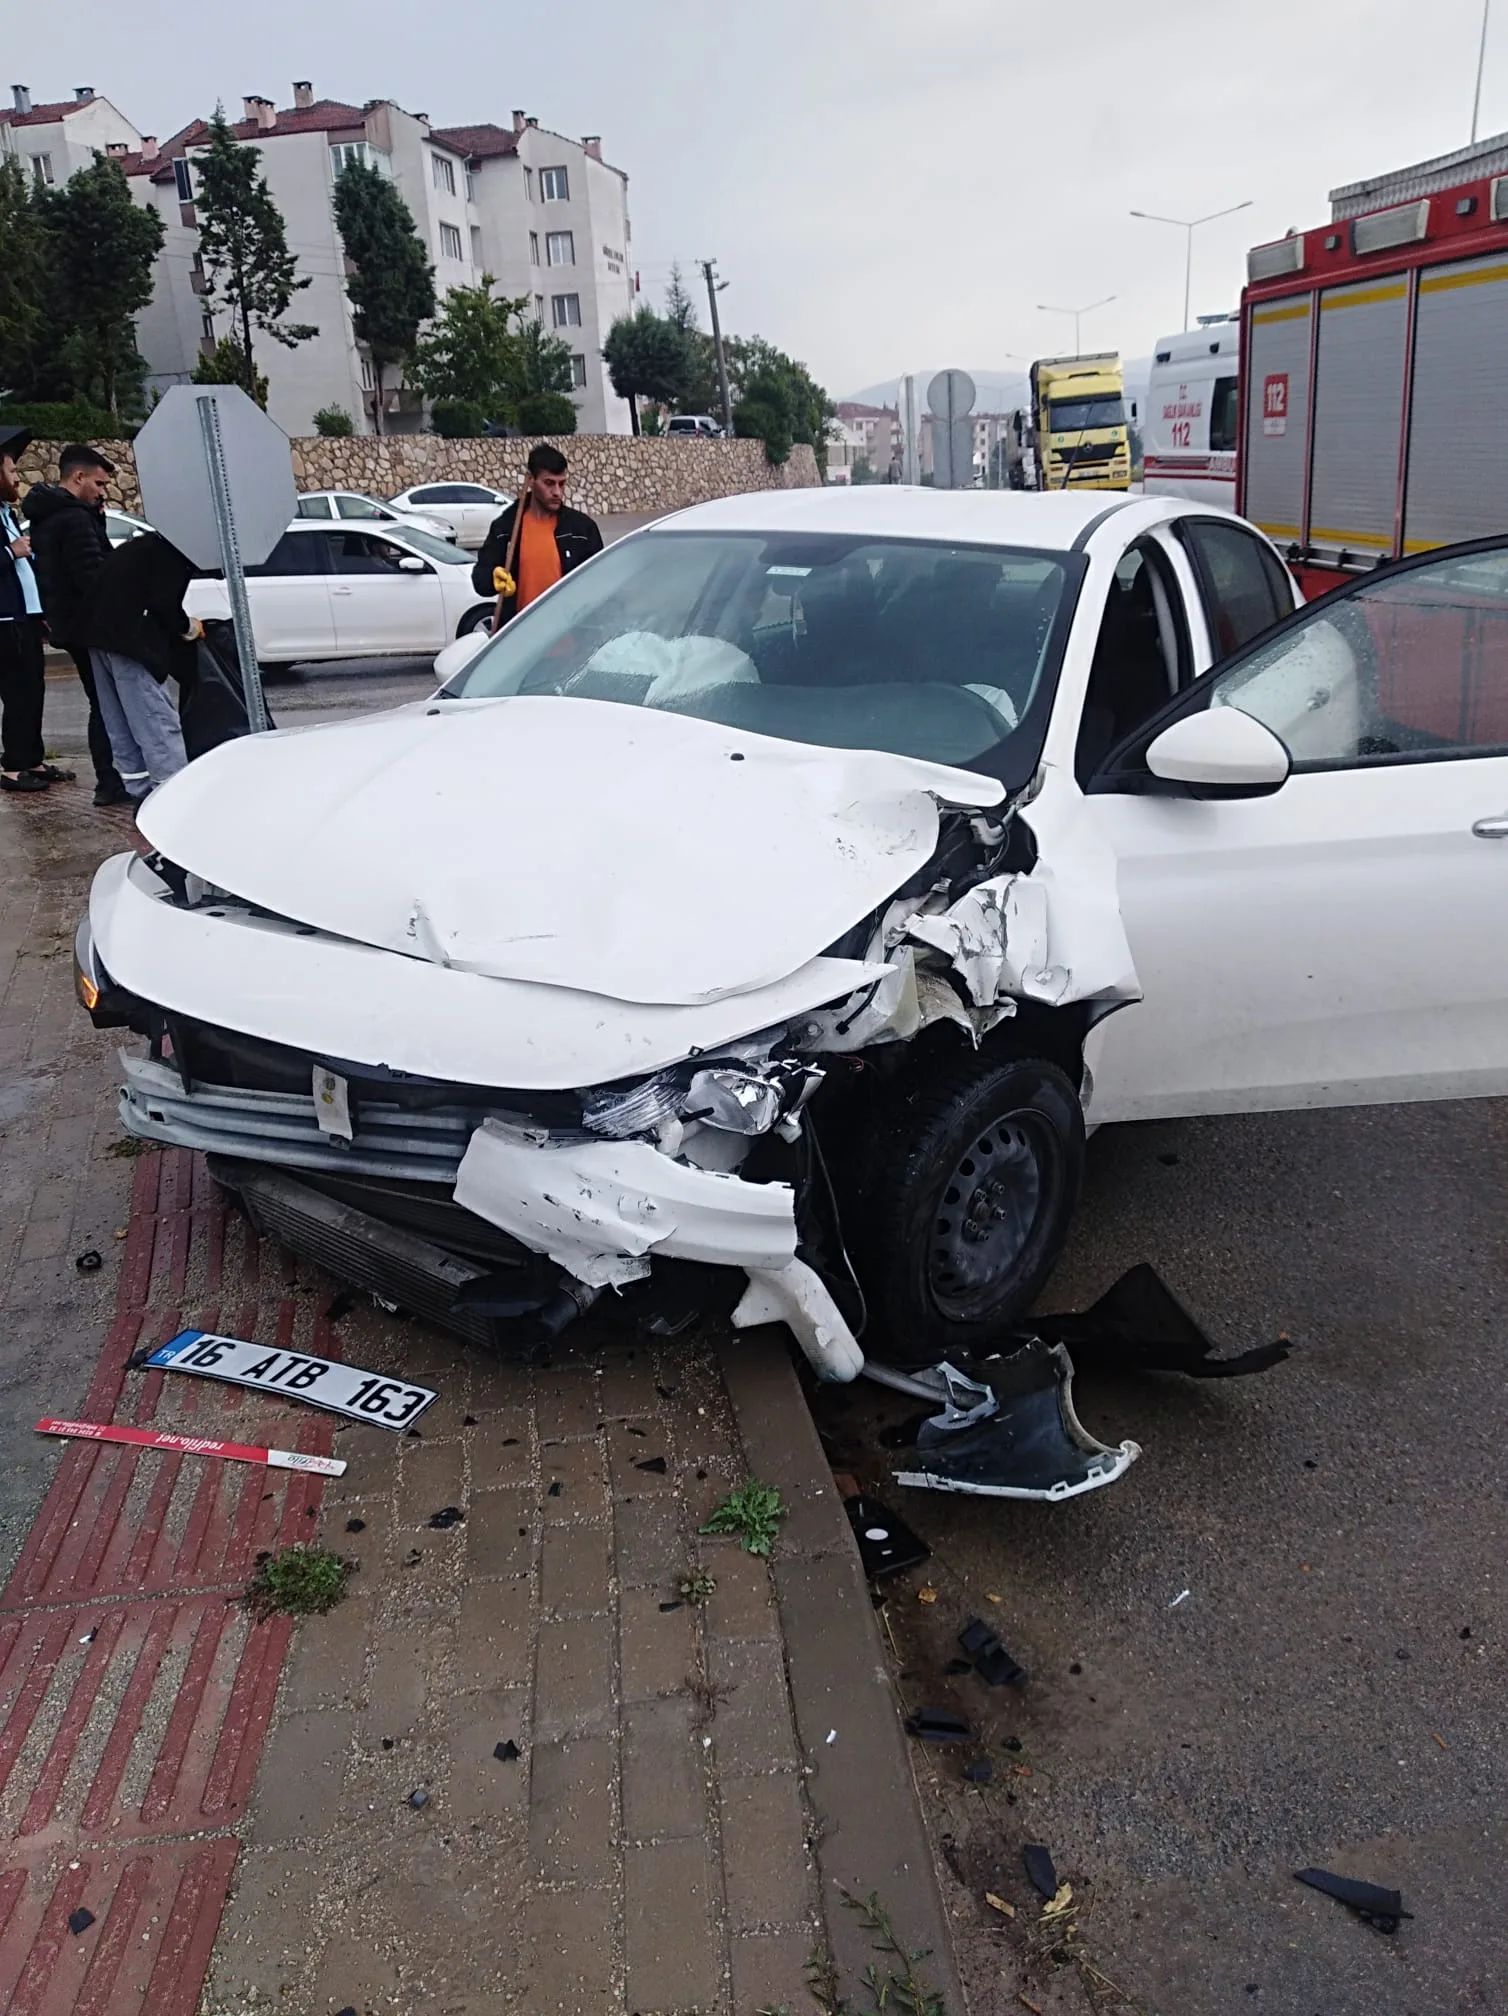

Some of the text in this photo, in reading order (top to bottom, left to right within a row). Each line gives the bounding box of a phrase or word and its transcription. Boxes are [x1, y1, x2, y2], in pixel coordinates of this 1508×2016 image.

[1267, 382, 1285, 412] 112
[1172, 421, 1191, 448] 112
[159, 1339, 426, 1421] TR 16 ATB 163
[155, 1433, 225, 1452] redfilo.net
